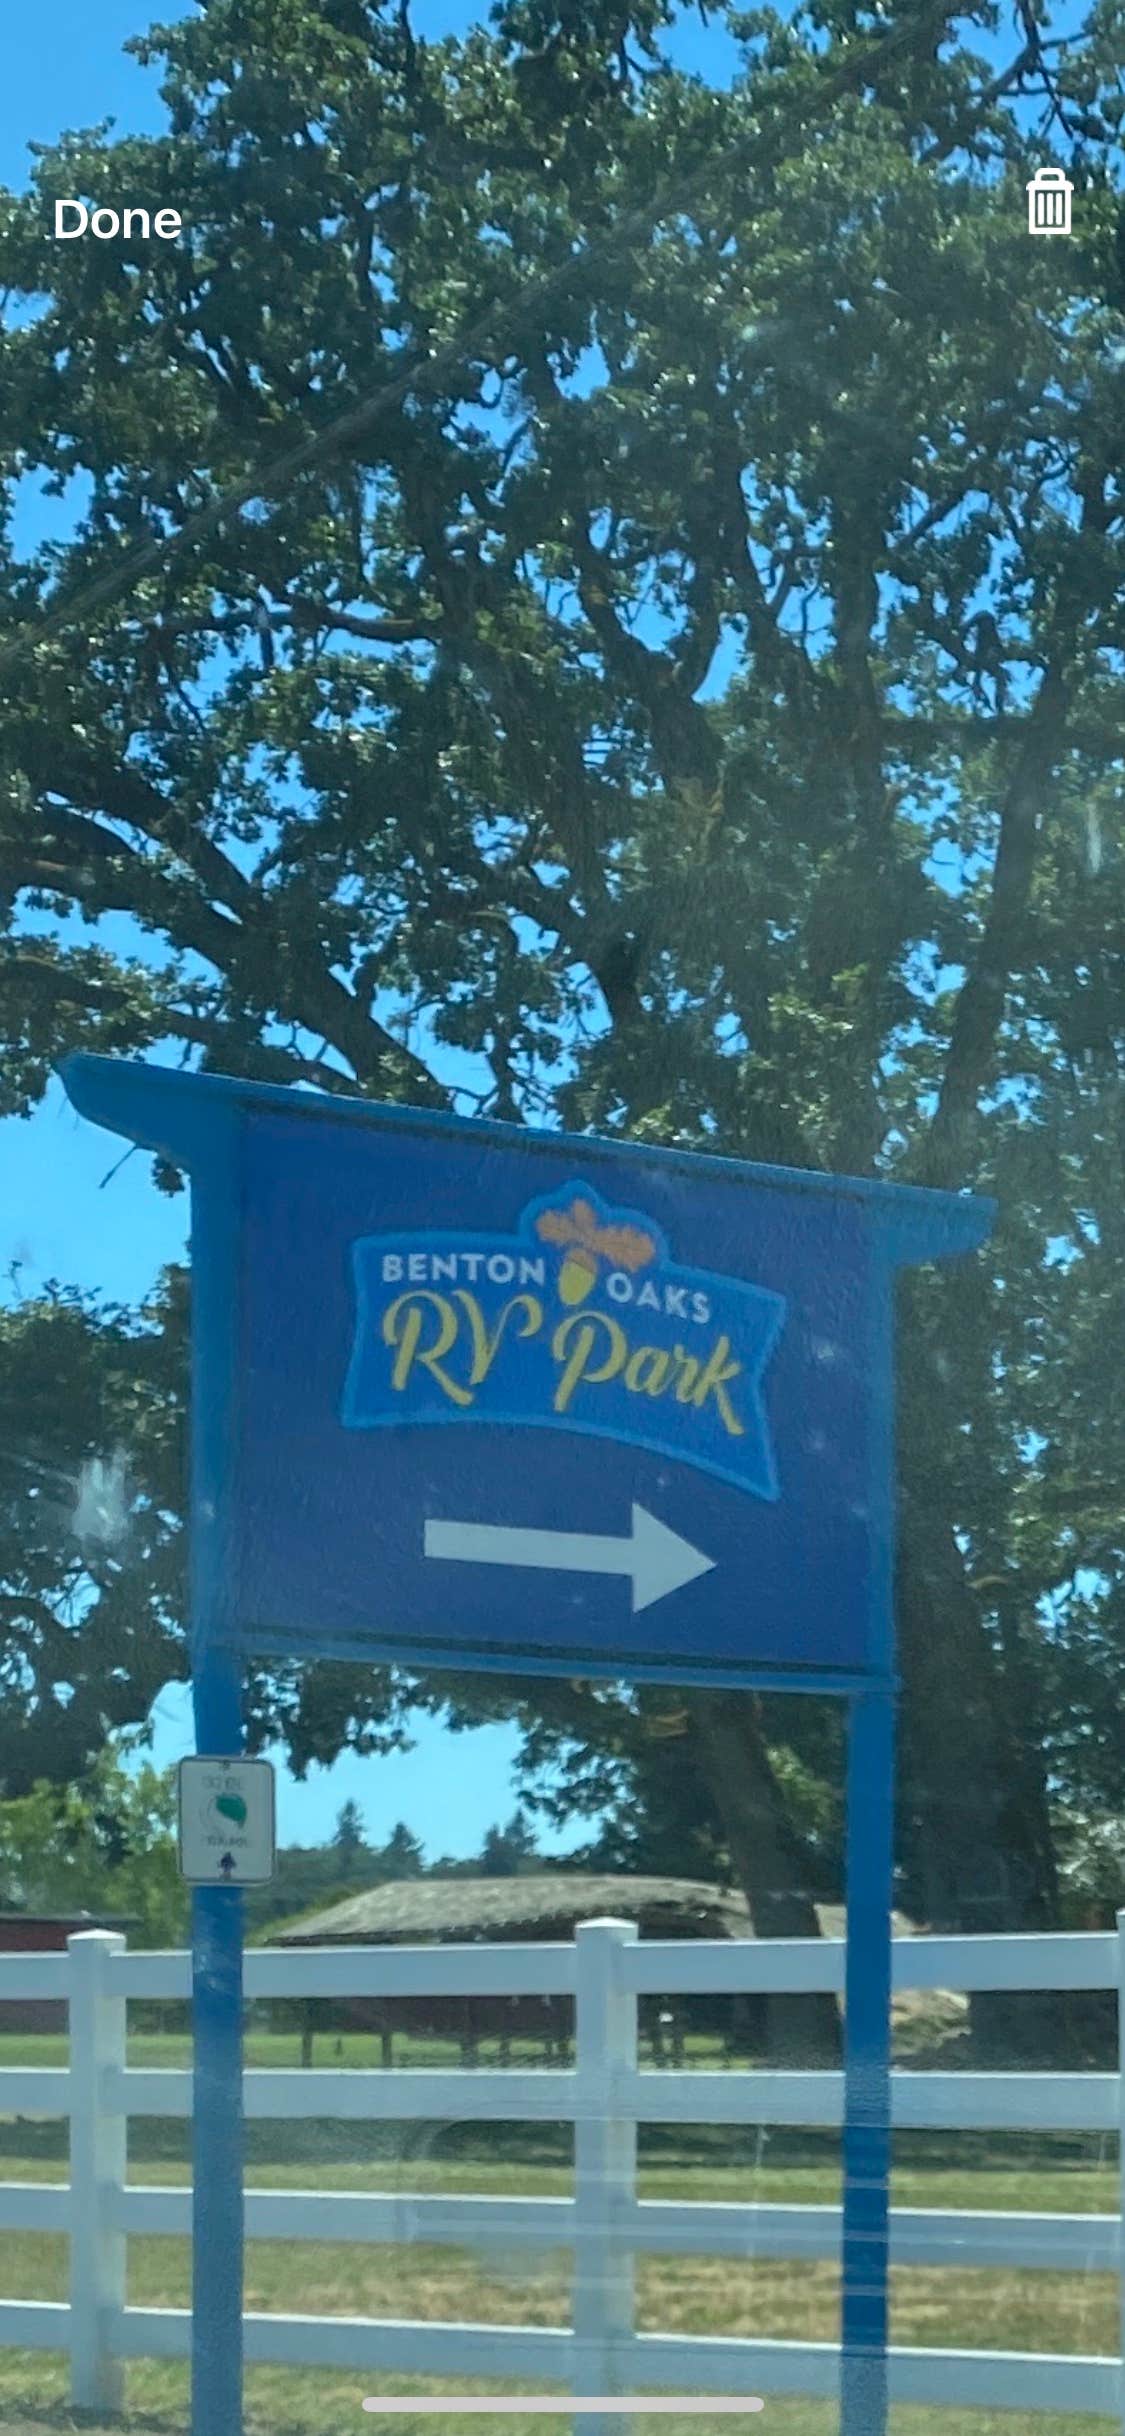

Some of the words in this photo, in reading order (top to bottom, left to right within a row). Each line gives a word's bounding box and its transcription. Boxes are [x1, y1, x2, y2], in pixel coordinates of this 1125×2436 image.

[382, 1253, 545, 1286] BENTON
[606, 1272, 711, 1325] OAKS
[382, 1289, 543, 1406] RV
[552, 1310, 745, 1436] Park
